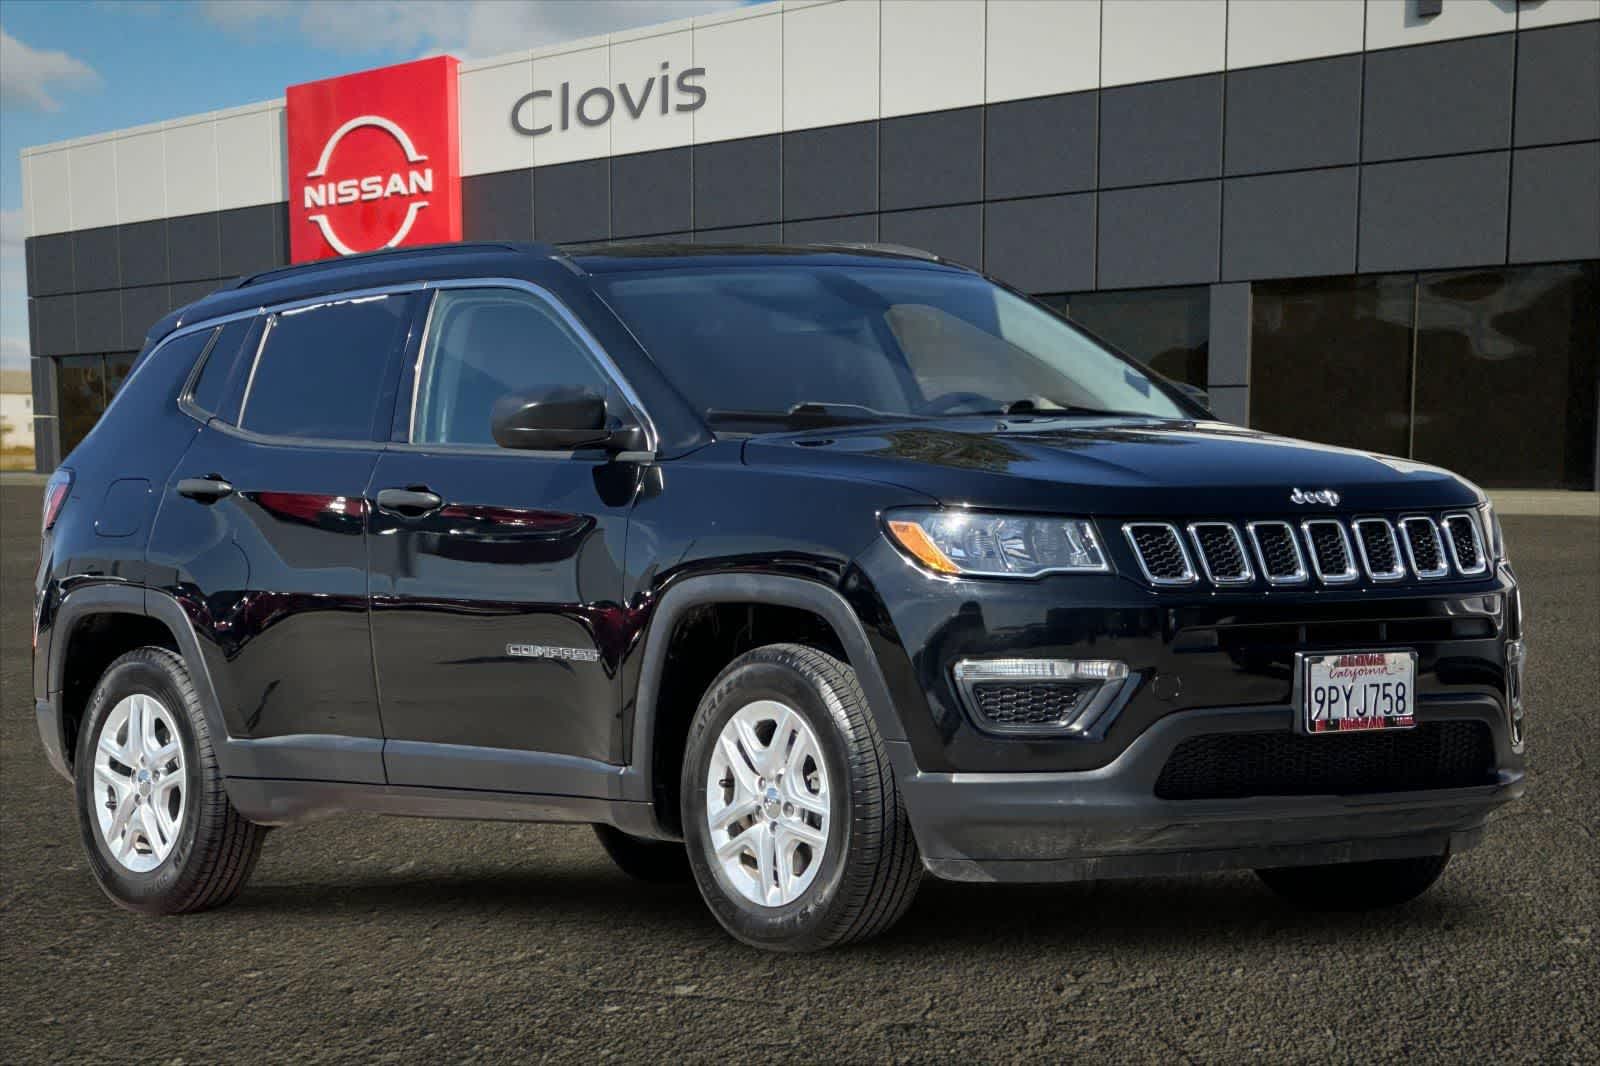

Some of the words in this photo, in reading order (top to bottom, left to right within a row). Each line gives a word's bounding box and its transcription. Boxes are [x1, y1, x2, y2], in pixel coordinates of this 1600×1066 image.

[510, 61, 707, 136] Clovis
[303, 167, 433, 209] NISSAN
[1290, 487, 1341, 507] Jeep
[505, 643, 600, 662] COMPASS
[1329, 666, 1396, 682] California
[1314, 681, 1407, 720] 9PYJ758
[1340, 715, 1385, 731] NISSAN
